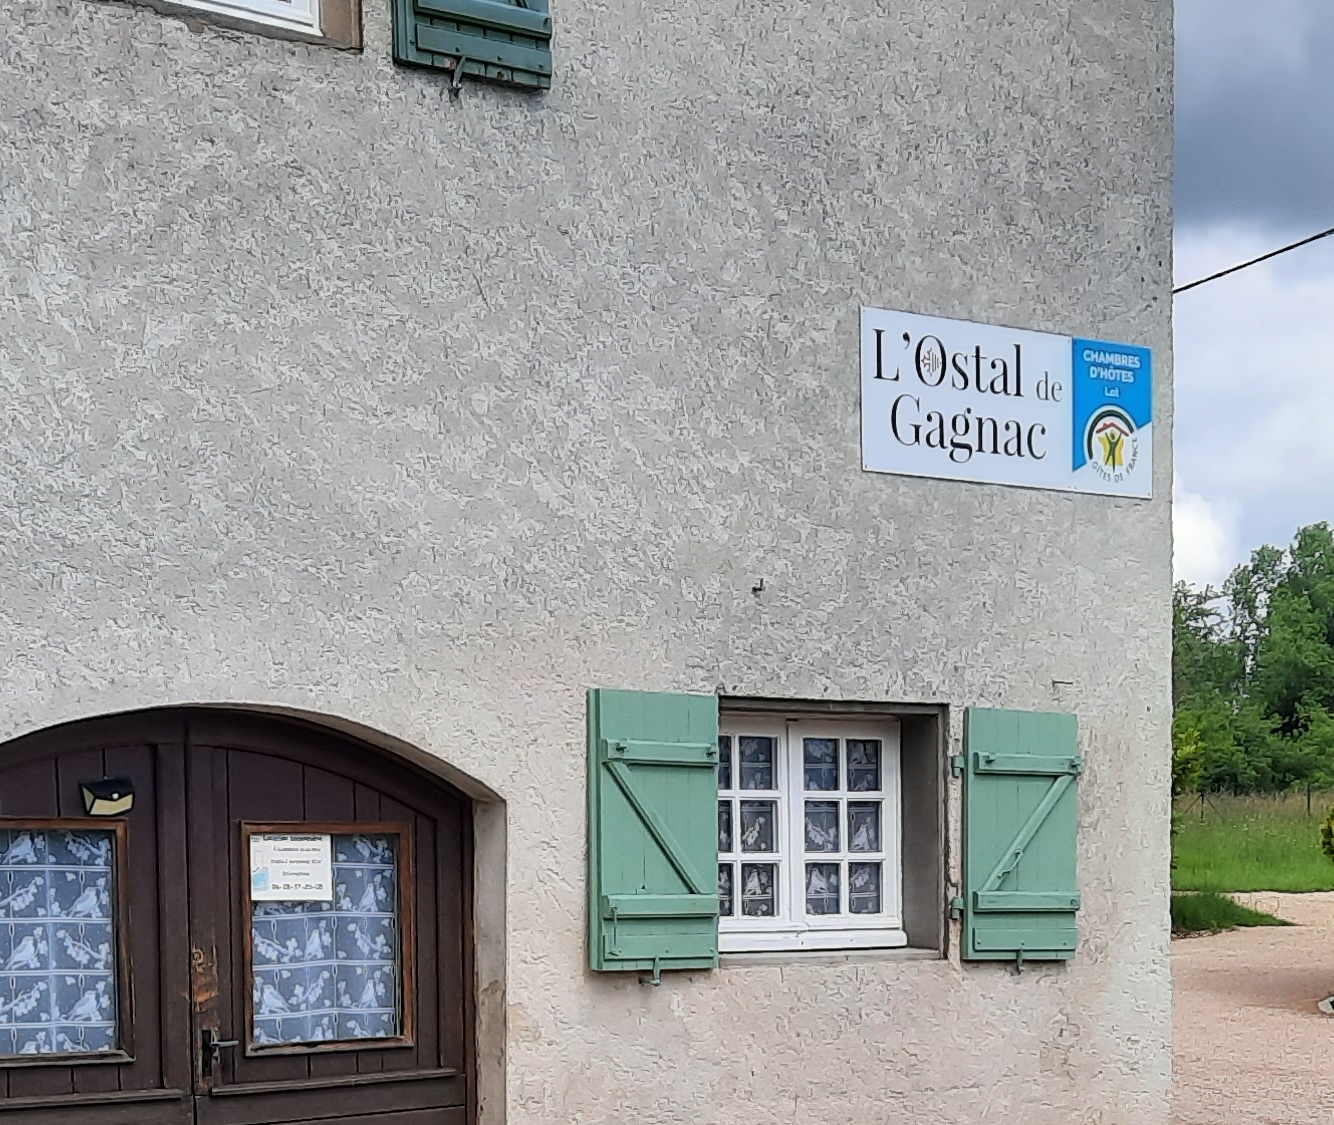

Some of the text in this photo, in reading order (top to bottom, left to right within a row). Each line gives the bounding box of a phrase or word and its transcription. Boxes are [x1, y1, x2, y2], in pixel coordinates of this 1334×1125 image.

[872, 328, 1062, 402] L'Ostal de
[1082, 349, 1141, 368] CHAMBRES
[1089, 364, 1134, 383] D'HÔTES
[890, 394, 1046, 463] Gagnac
[1125, 436, 1139, 476] FRANCE
